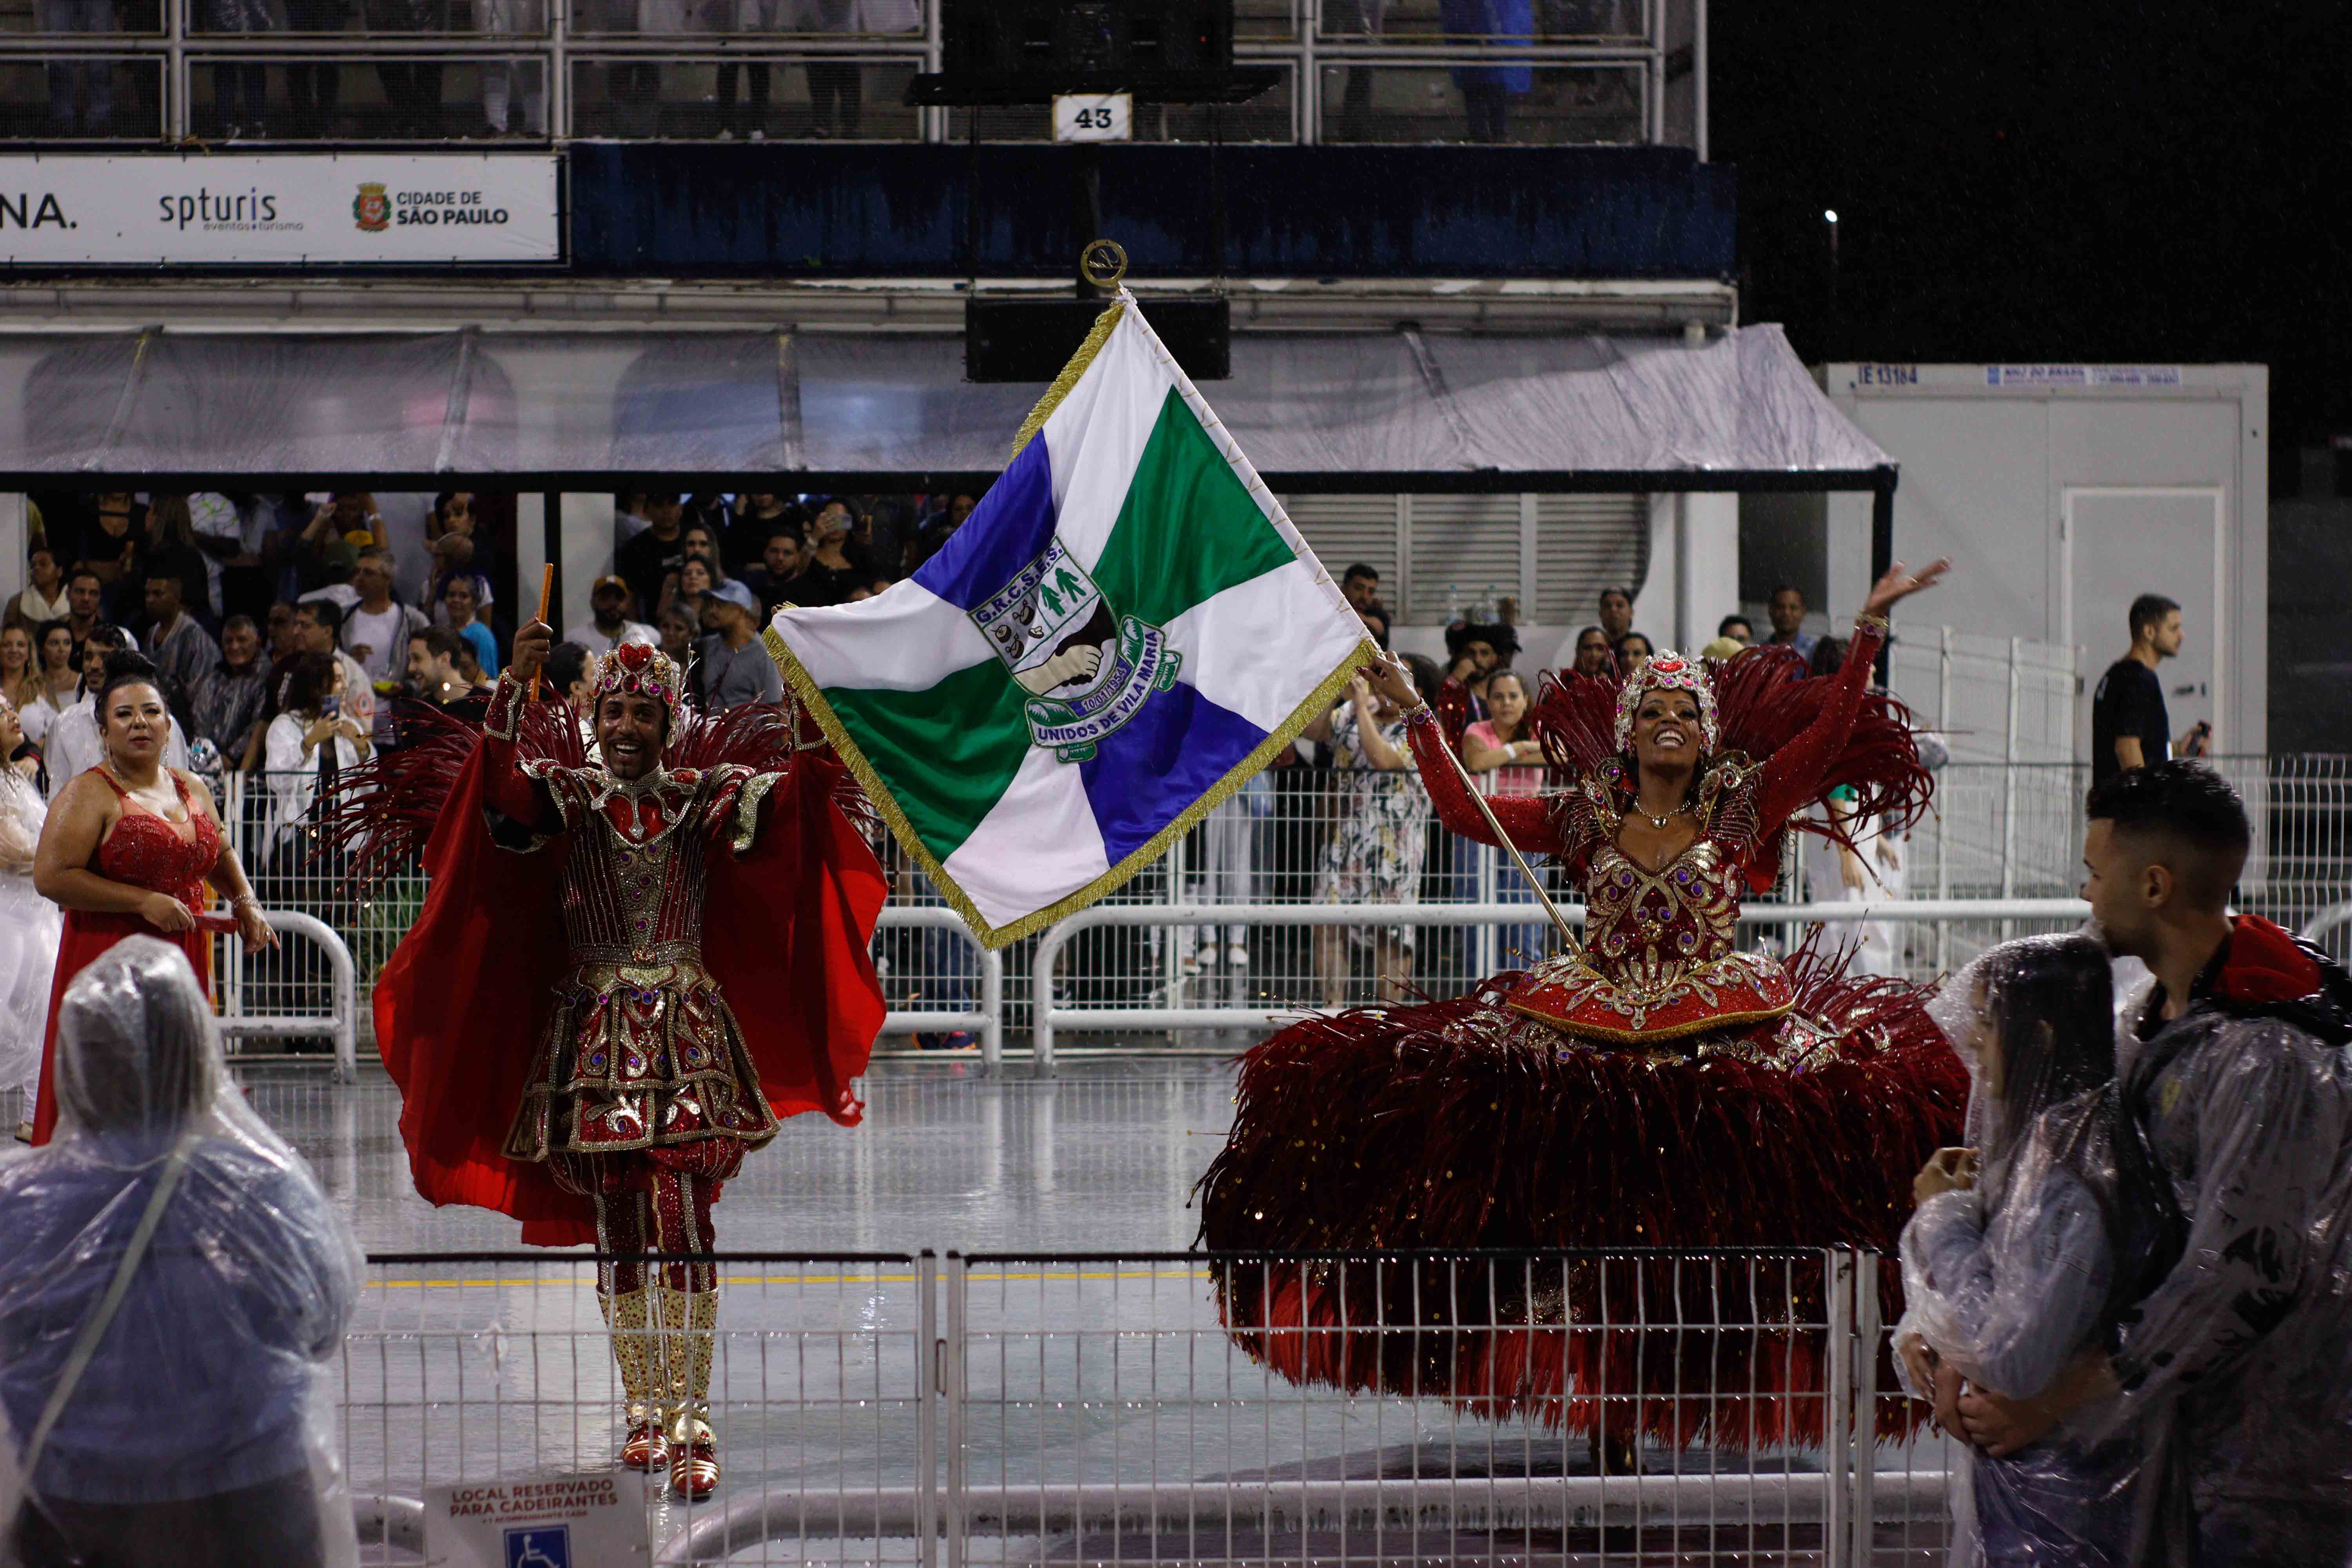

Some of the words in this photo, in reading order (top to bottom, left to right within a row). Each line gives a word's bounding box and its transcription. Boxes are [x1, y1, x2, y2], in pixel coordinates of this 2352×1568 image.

[1074, 108, 1111, 128] 43
[160, 187, 276, 230] spturis
[397, 191, 455, 205] CIDADE
[461, 191, 482, 204] DE
[397, 207, 439, 225] SÃO
[444, 209, 508, 224] PAULO
[976, 547, 1062, 622] G.R.C.S.E.S.
[1038, 724, 1098, 740] UNIDOS
[1099, 711, 1120, 730] DE
[1116, 683, 1145, 713] VILA
[1137, 631, 1157, 681] MARIA
[1083, 668, 1125, 710] 10/01/1954
[452, 1488, 508, 1503] LOCAL
[513, 1479, 613, 1498] RESERVADO
[450, 1503, 494, 1517] PARA
[500, 1492, 618, 1513] CADEIRANTES
